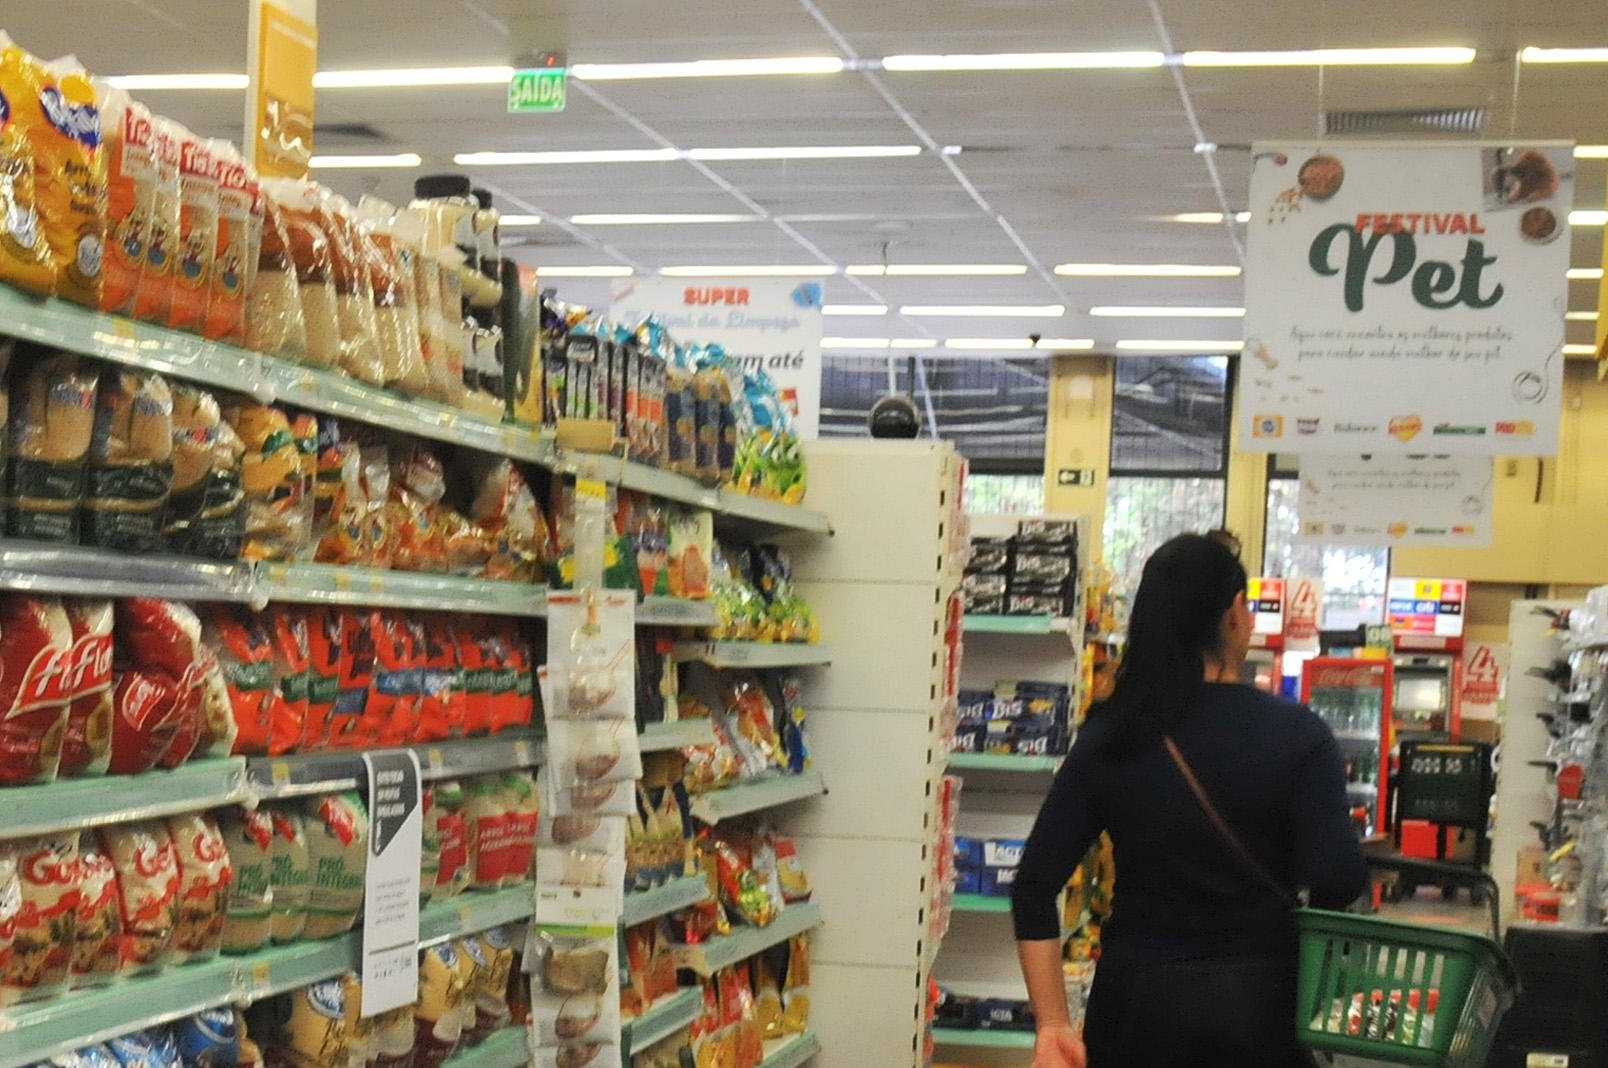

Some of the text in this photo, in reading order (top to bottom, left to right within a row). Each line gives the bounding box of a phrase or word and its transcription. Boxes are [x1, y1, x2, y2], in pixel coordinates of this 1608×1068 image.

[1355, 212, 1486, 235] FESTIVAL
[1308, 222, 1504, 312] Pet
[683, 286, 750, 305] SUPER
[769, 350, 804, 370] até
